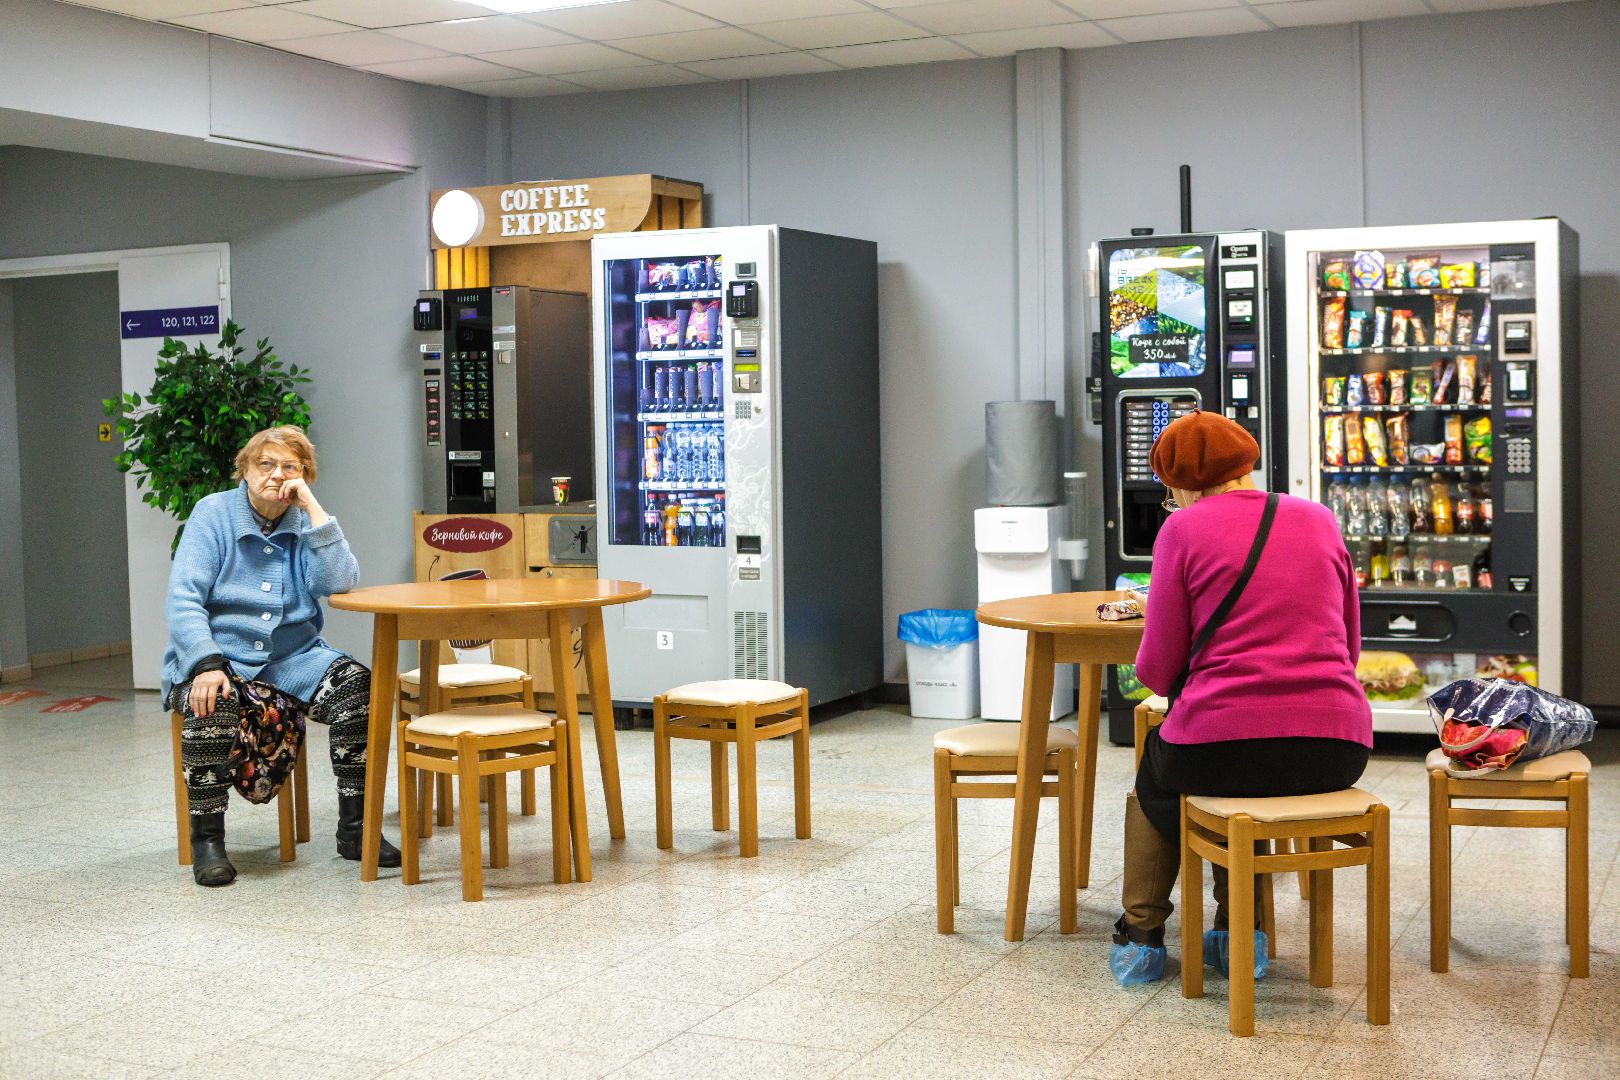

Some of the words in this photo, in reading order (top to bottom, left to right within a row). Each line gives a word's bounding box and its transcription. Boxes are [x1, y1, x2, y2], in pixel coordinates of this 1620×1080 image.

[500, 183, 590, 212] COFFEE
[500, 207, 606, 238] EXPRESS
[161, 317, 180, 329] 120,
[182, 316, 198, 328] 121,
[200, 315, 215, 326] 122
[431, 527, 478, 545] Зерновой
[478, 528, 504, 544] кофе
[745, 556, 752, 565] 4
[661, 634, 669, 646] 3
